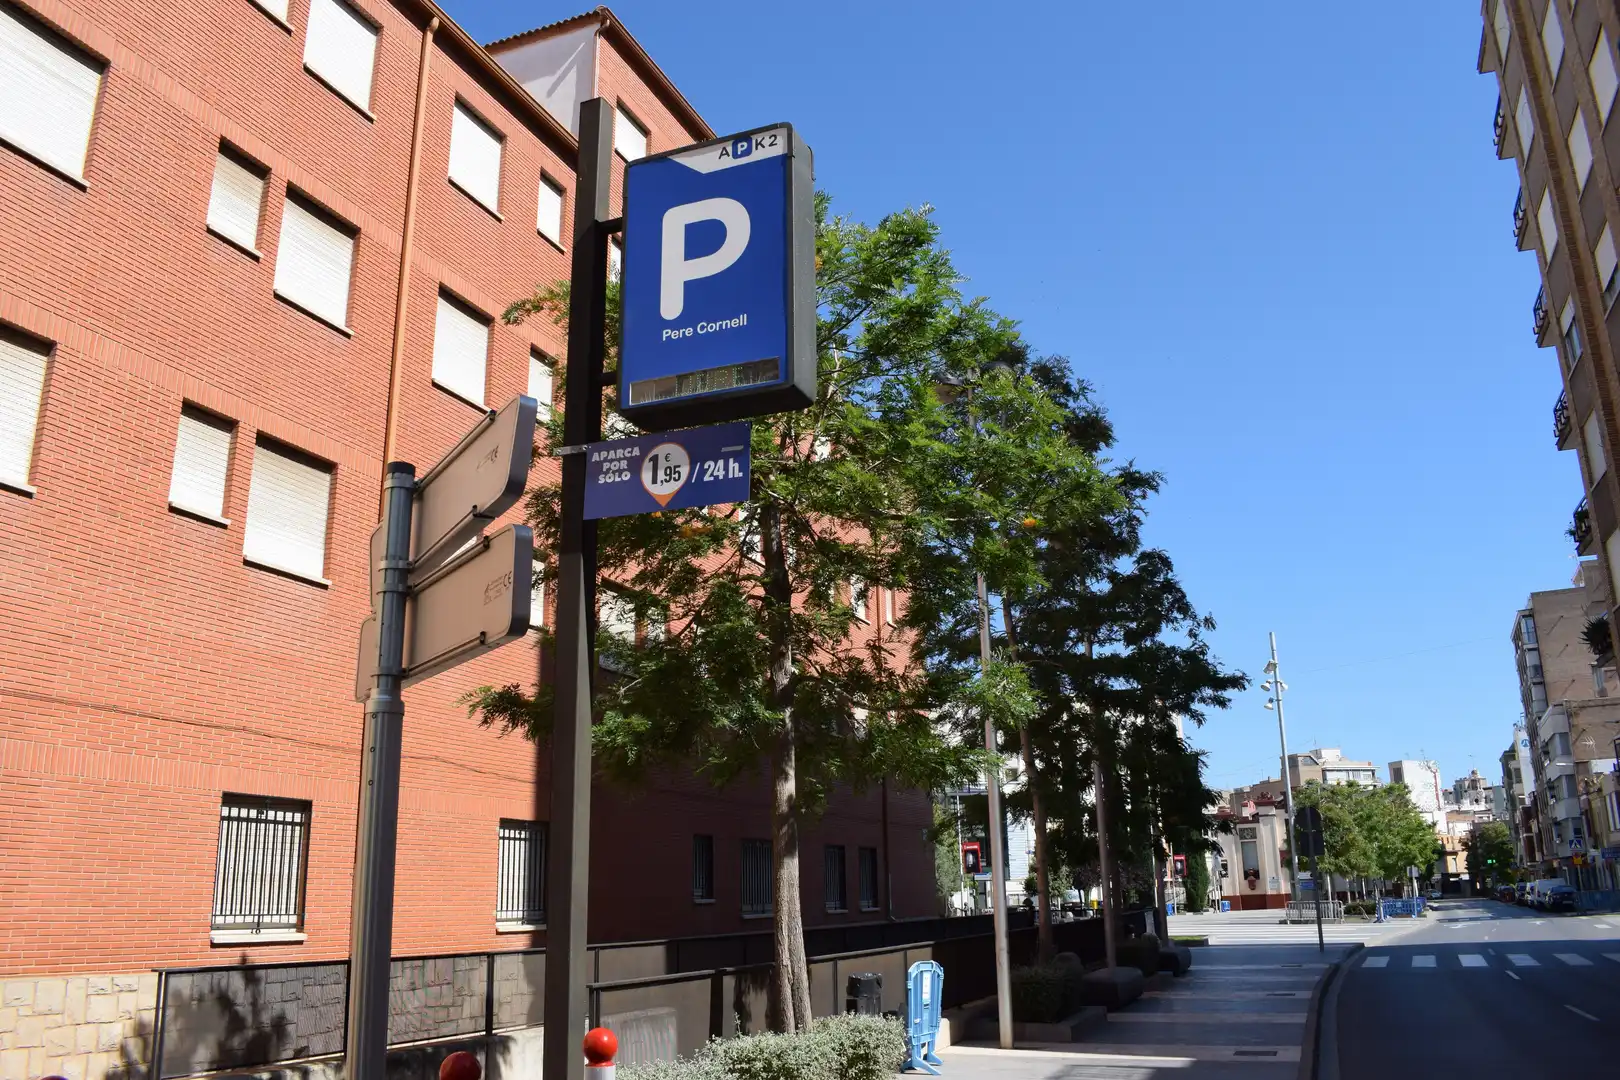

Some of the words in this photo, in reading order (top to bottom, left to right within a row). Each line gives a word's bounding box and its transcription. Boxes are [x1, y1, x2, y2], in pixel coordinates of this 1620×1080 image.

[660, 197, 751, 320] P
[662, 327, 693, 342] Pere
[697, 313, 748, 334] Cornell
[591, 446, 641, 462] APARCA
[602, 460, 628, 472] POR
[703, 458, 726, 482] 24
[598, 469, 631, 484] SÓLO
